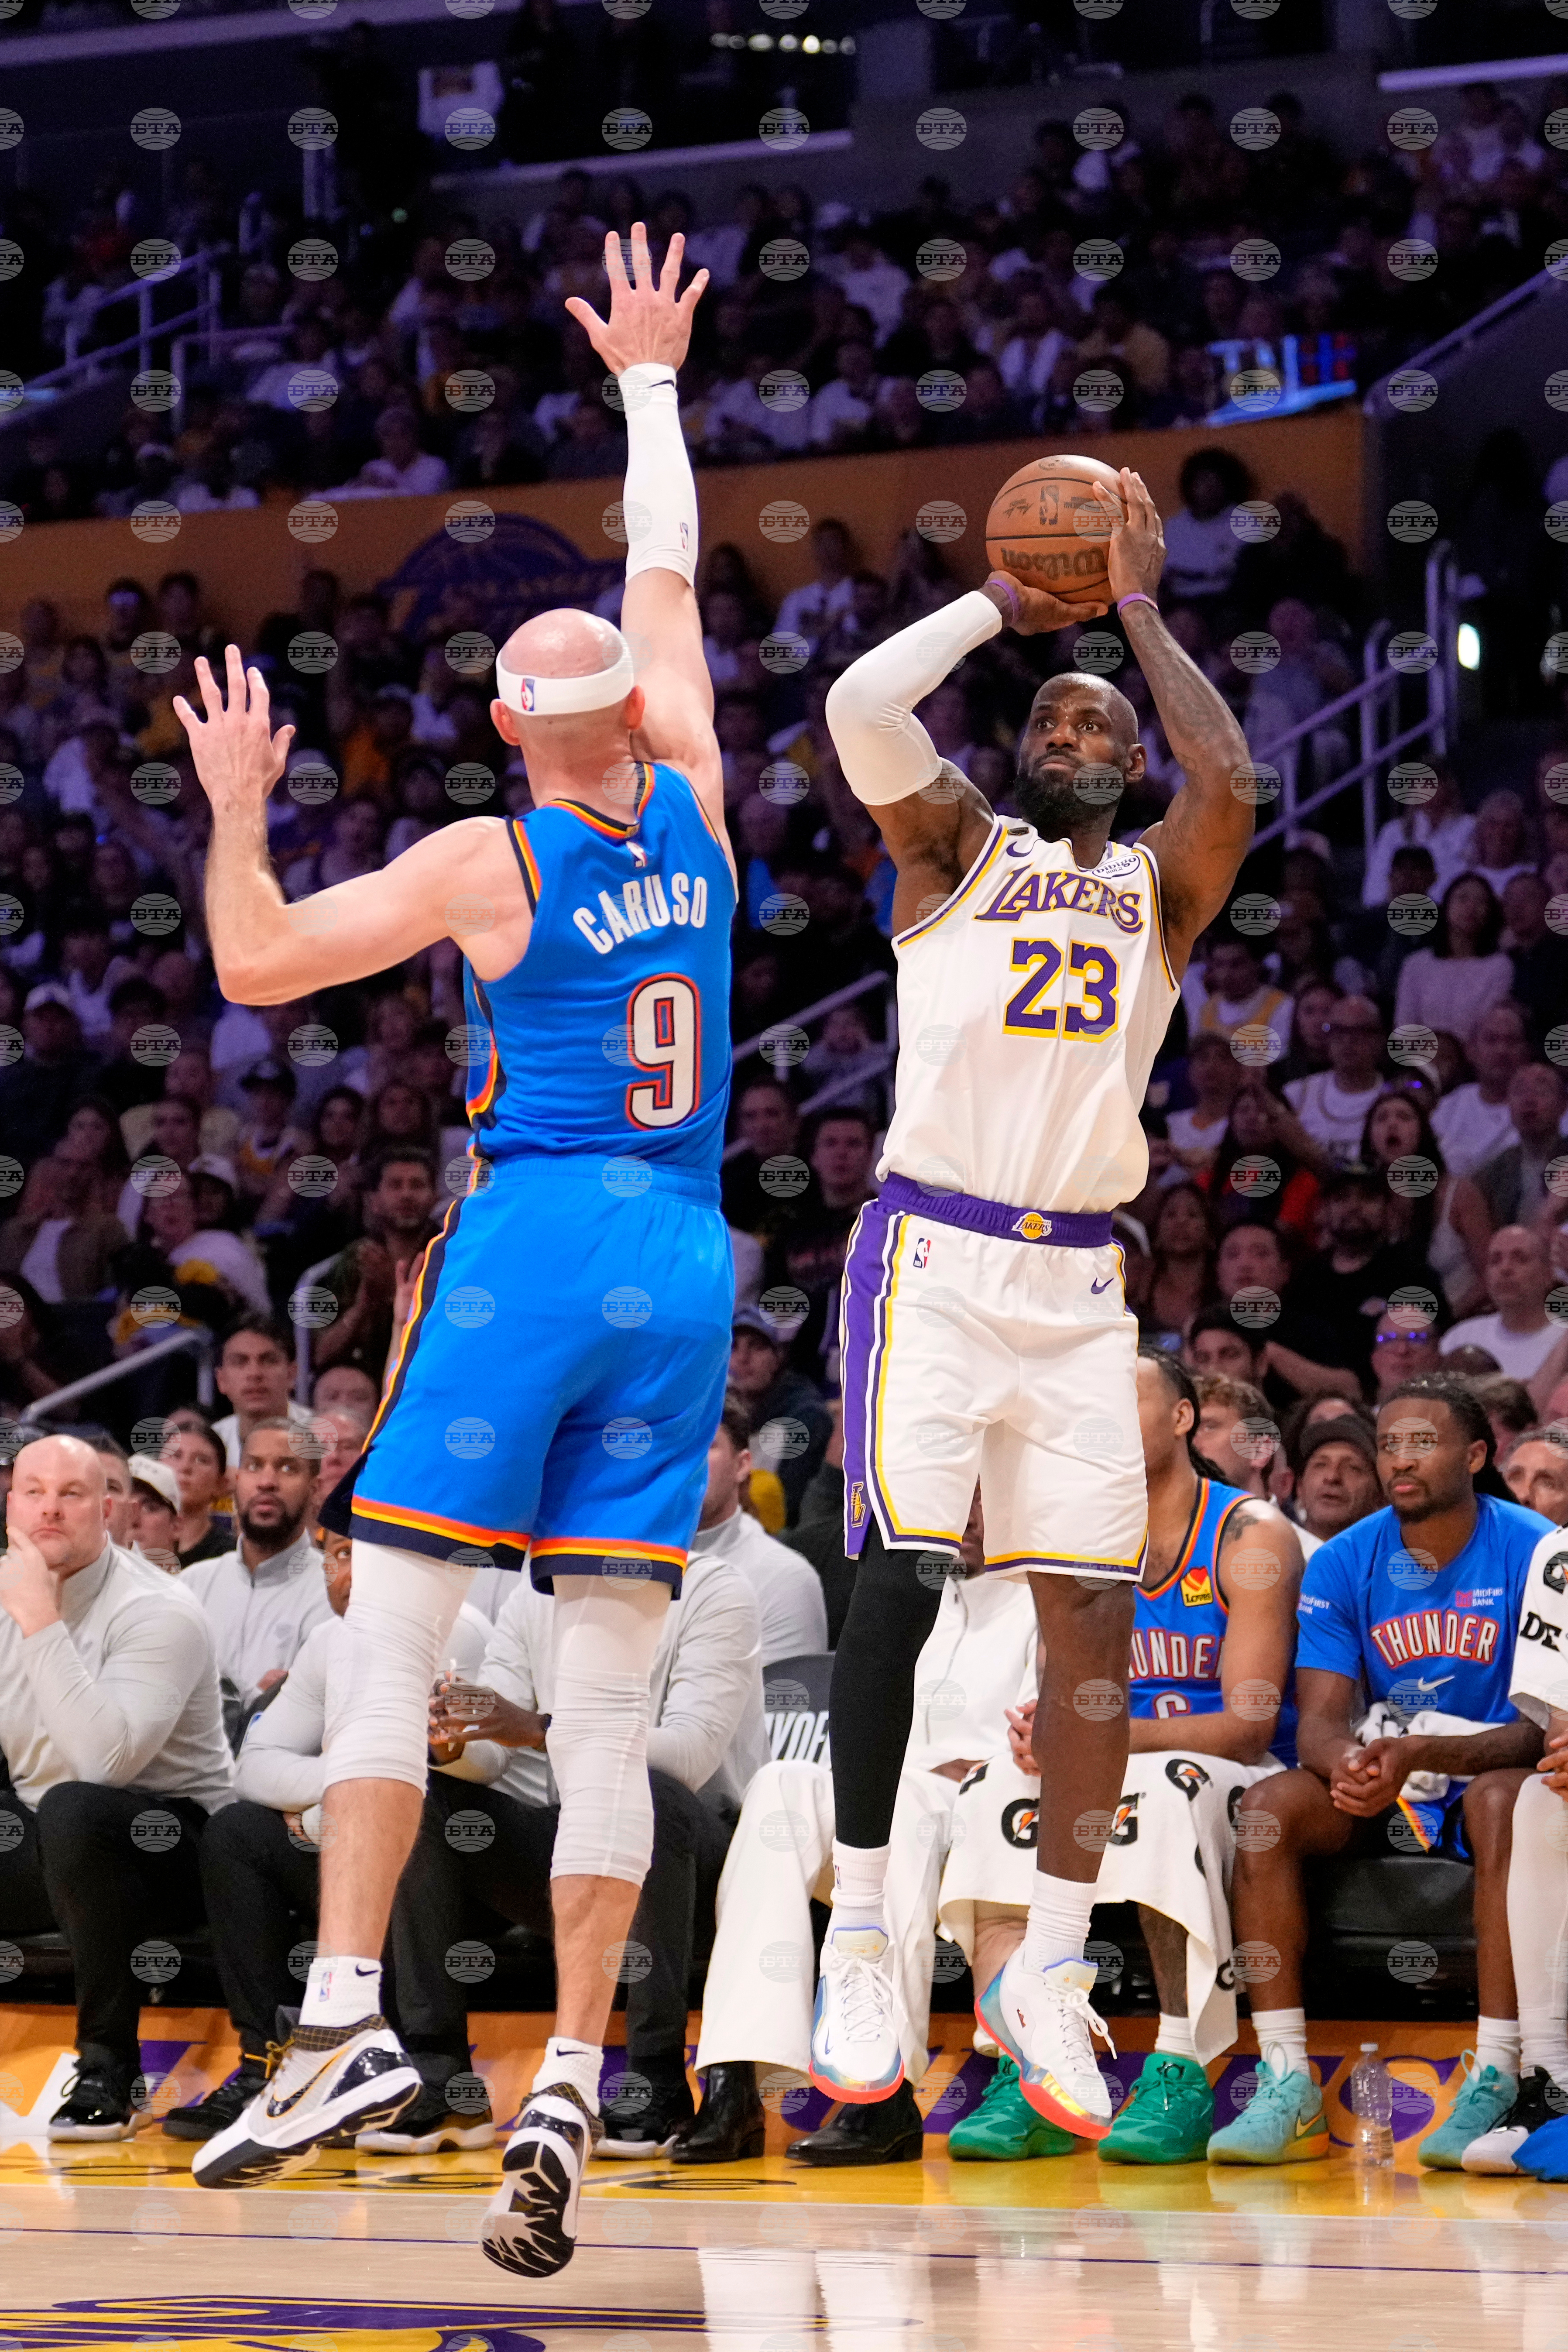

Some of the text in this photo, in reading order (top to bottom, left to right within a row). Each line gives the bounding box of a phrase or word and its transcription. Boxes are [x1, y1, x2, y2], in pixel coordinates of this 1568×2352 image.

[971, 862, 1146, 935] LAKERS
[1096, 857, 1136, 873] bibigo
[573, 872, 707, 955] CARUSO
[1002, 937, 1120, 1044] 23
[627, 973, 700, 1130] 9
[1015, 1218, 1050, 1234] LAKERS
[1371, 1611, 1498, 1668] THUNDER
